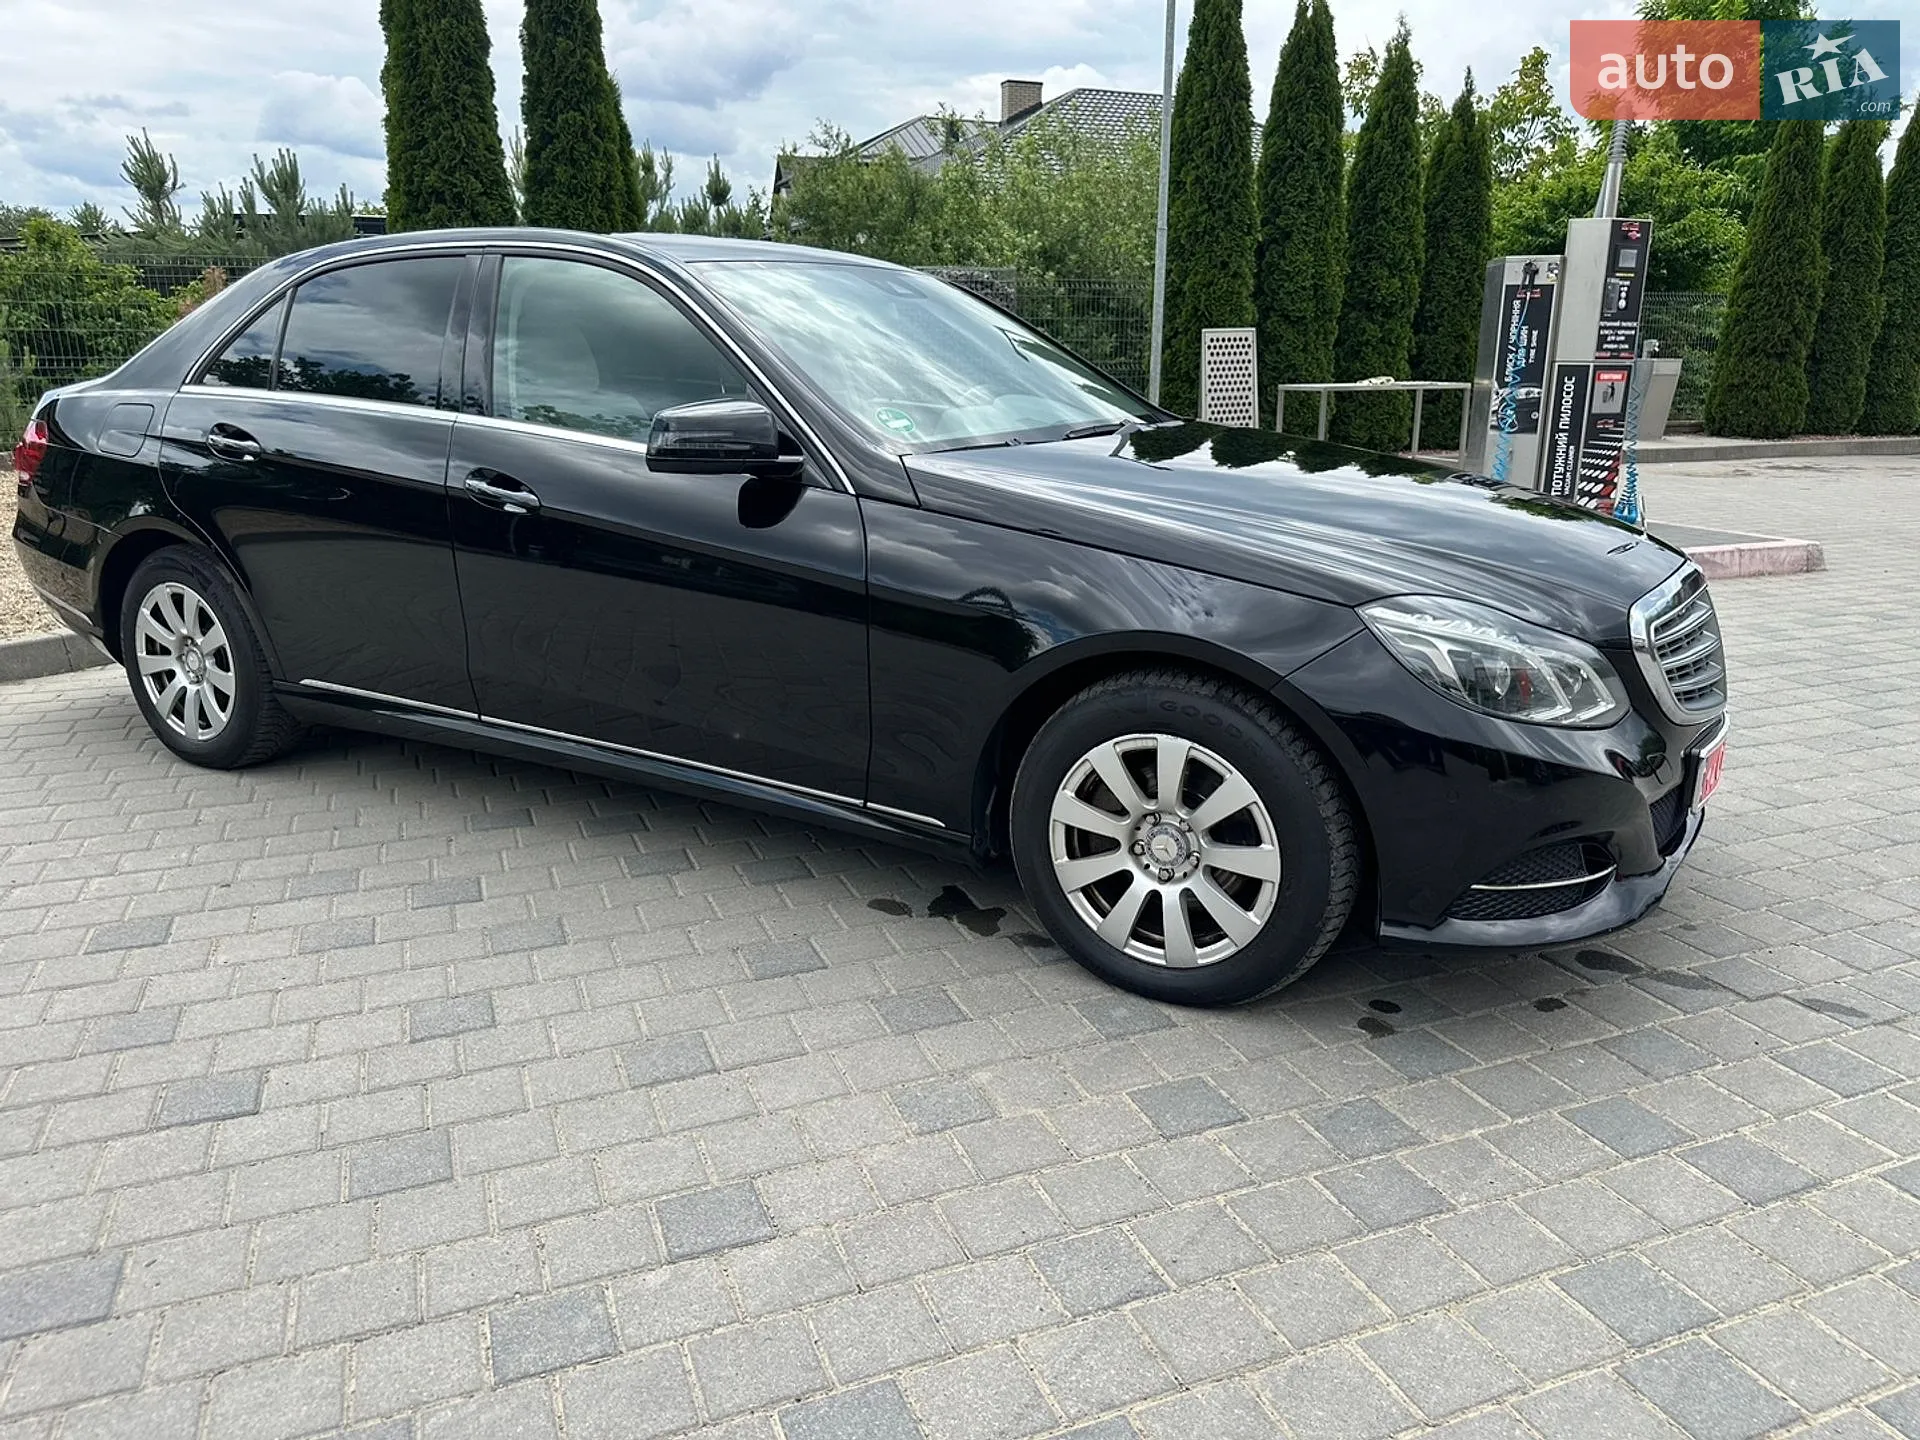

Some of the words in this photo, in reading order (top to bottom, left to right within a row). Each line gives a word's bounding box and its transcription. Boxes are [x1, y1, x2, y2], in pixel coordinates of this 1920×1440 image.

[1558, 375, 1576, 429] ПИЛОСОС
[1550, 432, 1569, 496] ПОТУЖНИЙ
[1566, 445, 1575, 471] CLEANER
[1563, 471, 1572, 496] VACUUM
